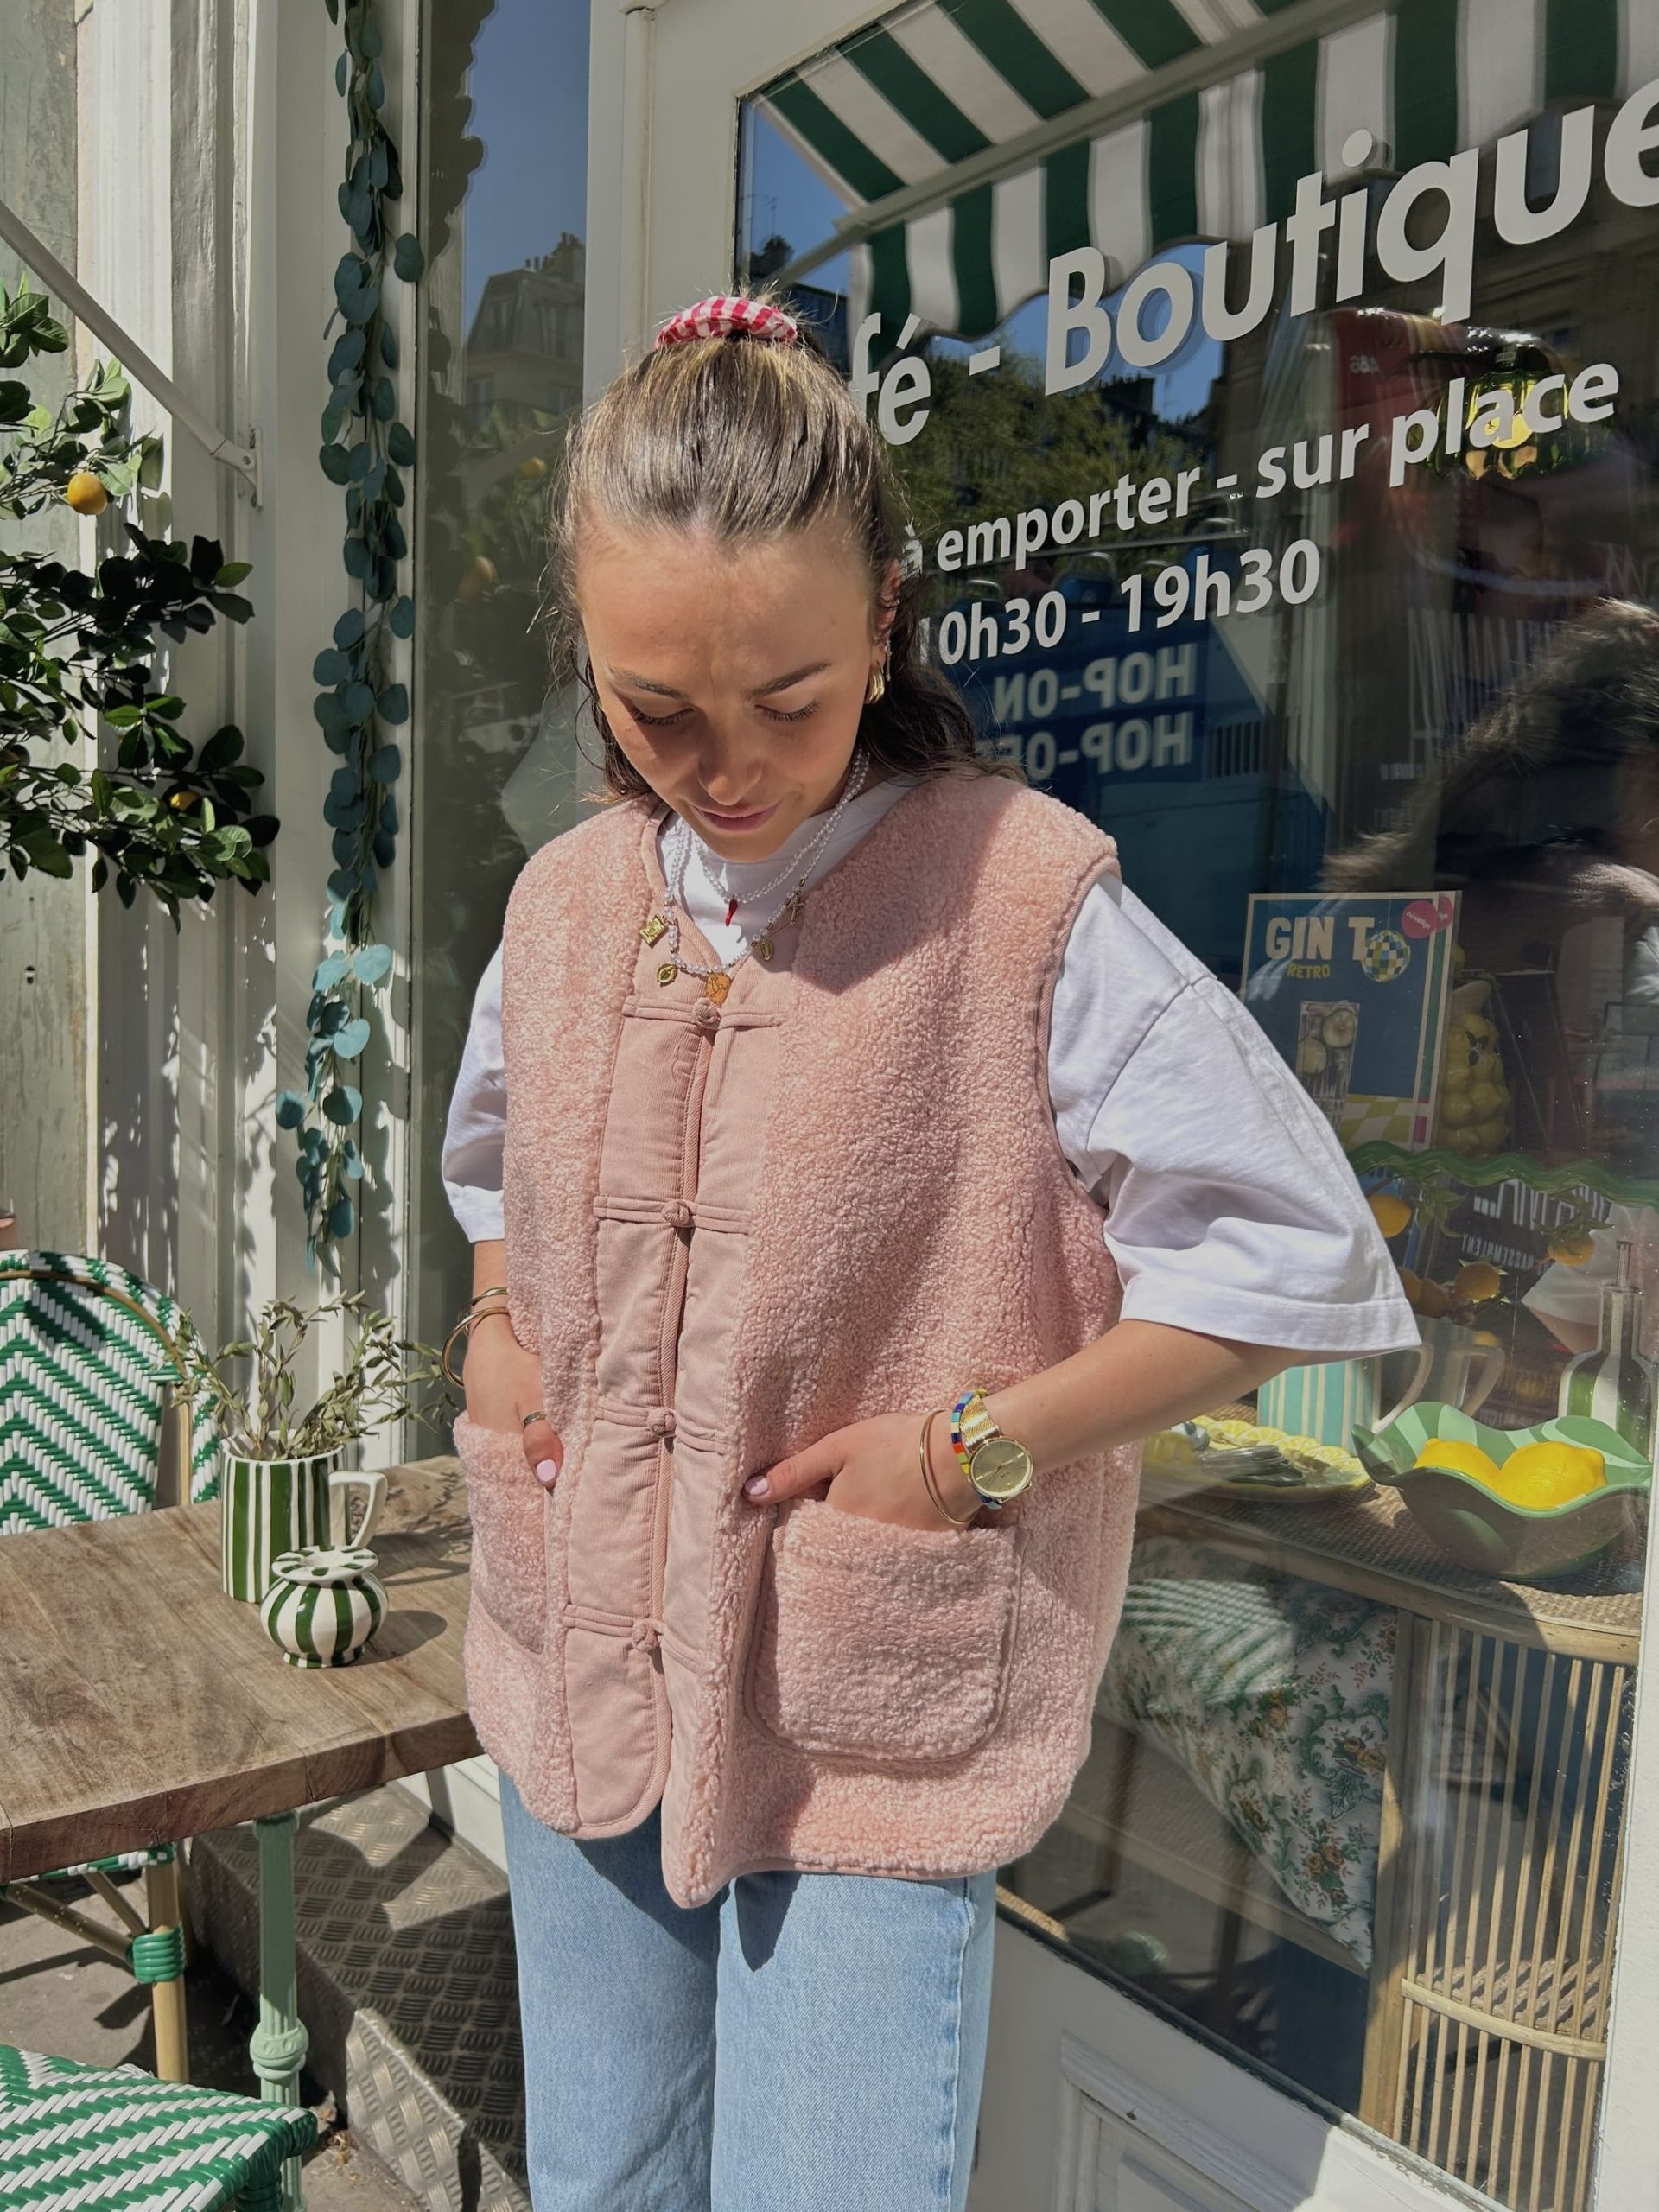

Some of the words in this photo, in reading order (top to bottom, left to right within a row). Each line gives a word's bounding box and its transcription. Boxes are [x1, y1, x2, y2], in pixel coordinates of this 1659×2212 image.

[1045, 79, 1659, 397] Boutique
[937, 467, 1200, 572] emporter
[1256, 423, 1369, 499] sur
[1389, 362, 1620, 487] place
[1121, 537, 1320, 633] 19h30
[1266, 916, 1335, 961] GIN
[1287, 963, 1331, 979] RETRO
